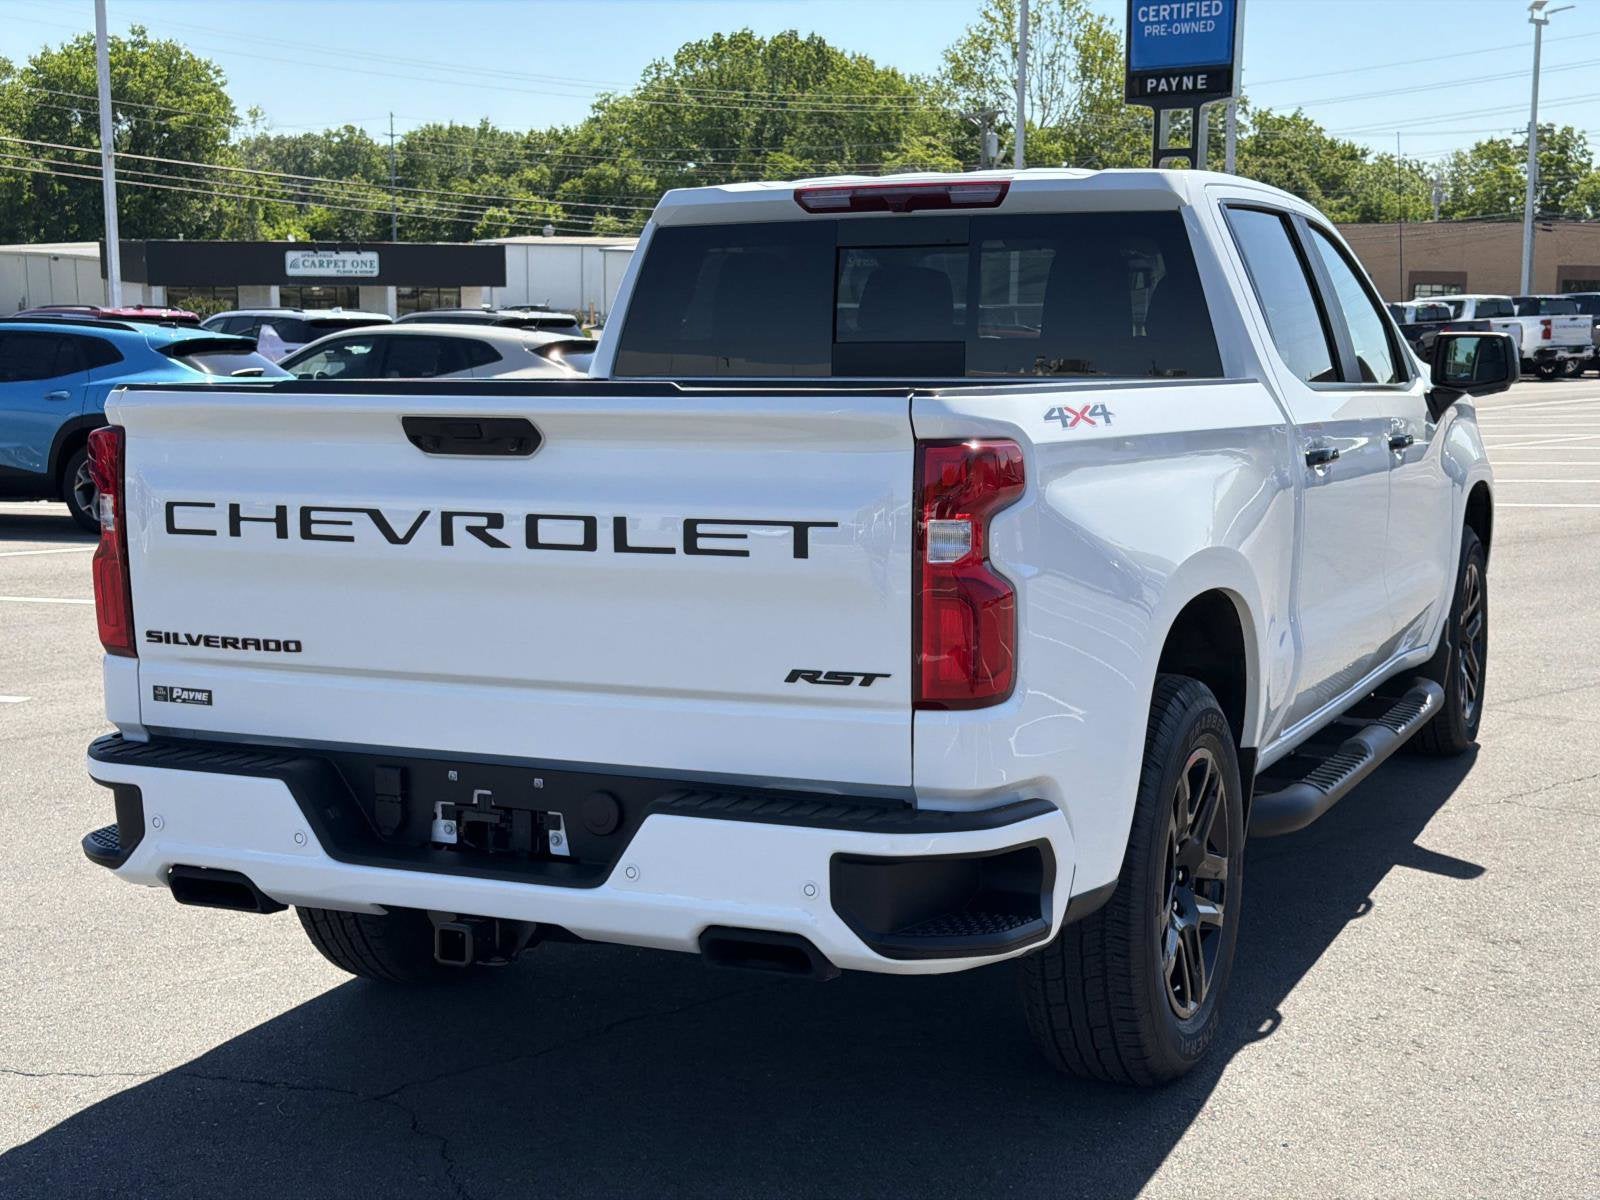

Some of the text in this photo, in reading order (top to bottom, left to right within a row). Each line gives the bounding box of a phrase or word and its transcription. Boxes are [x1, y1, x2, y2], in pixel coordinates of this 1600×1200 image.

[1137, 1, 1223, 22] CERTIFIED
[1144, 20, 1215, 37] PRE-OWNED
[1146, 75, 1208, 93] PAYNE
[301, 259, 376, 269] CARPET ONE
[164, 500, 839, 560] CHEVROLET
[145, 630, 303, 653] SILVERADO
[783, 669, 892, 687] RST
